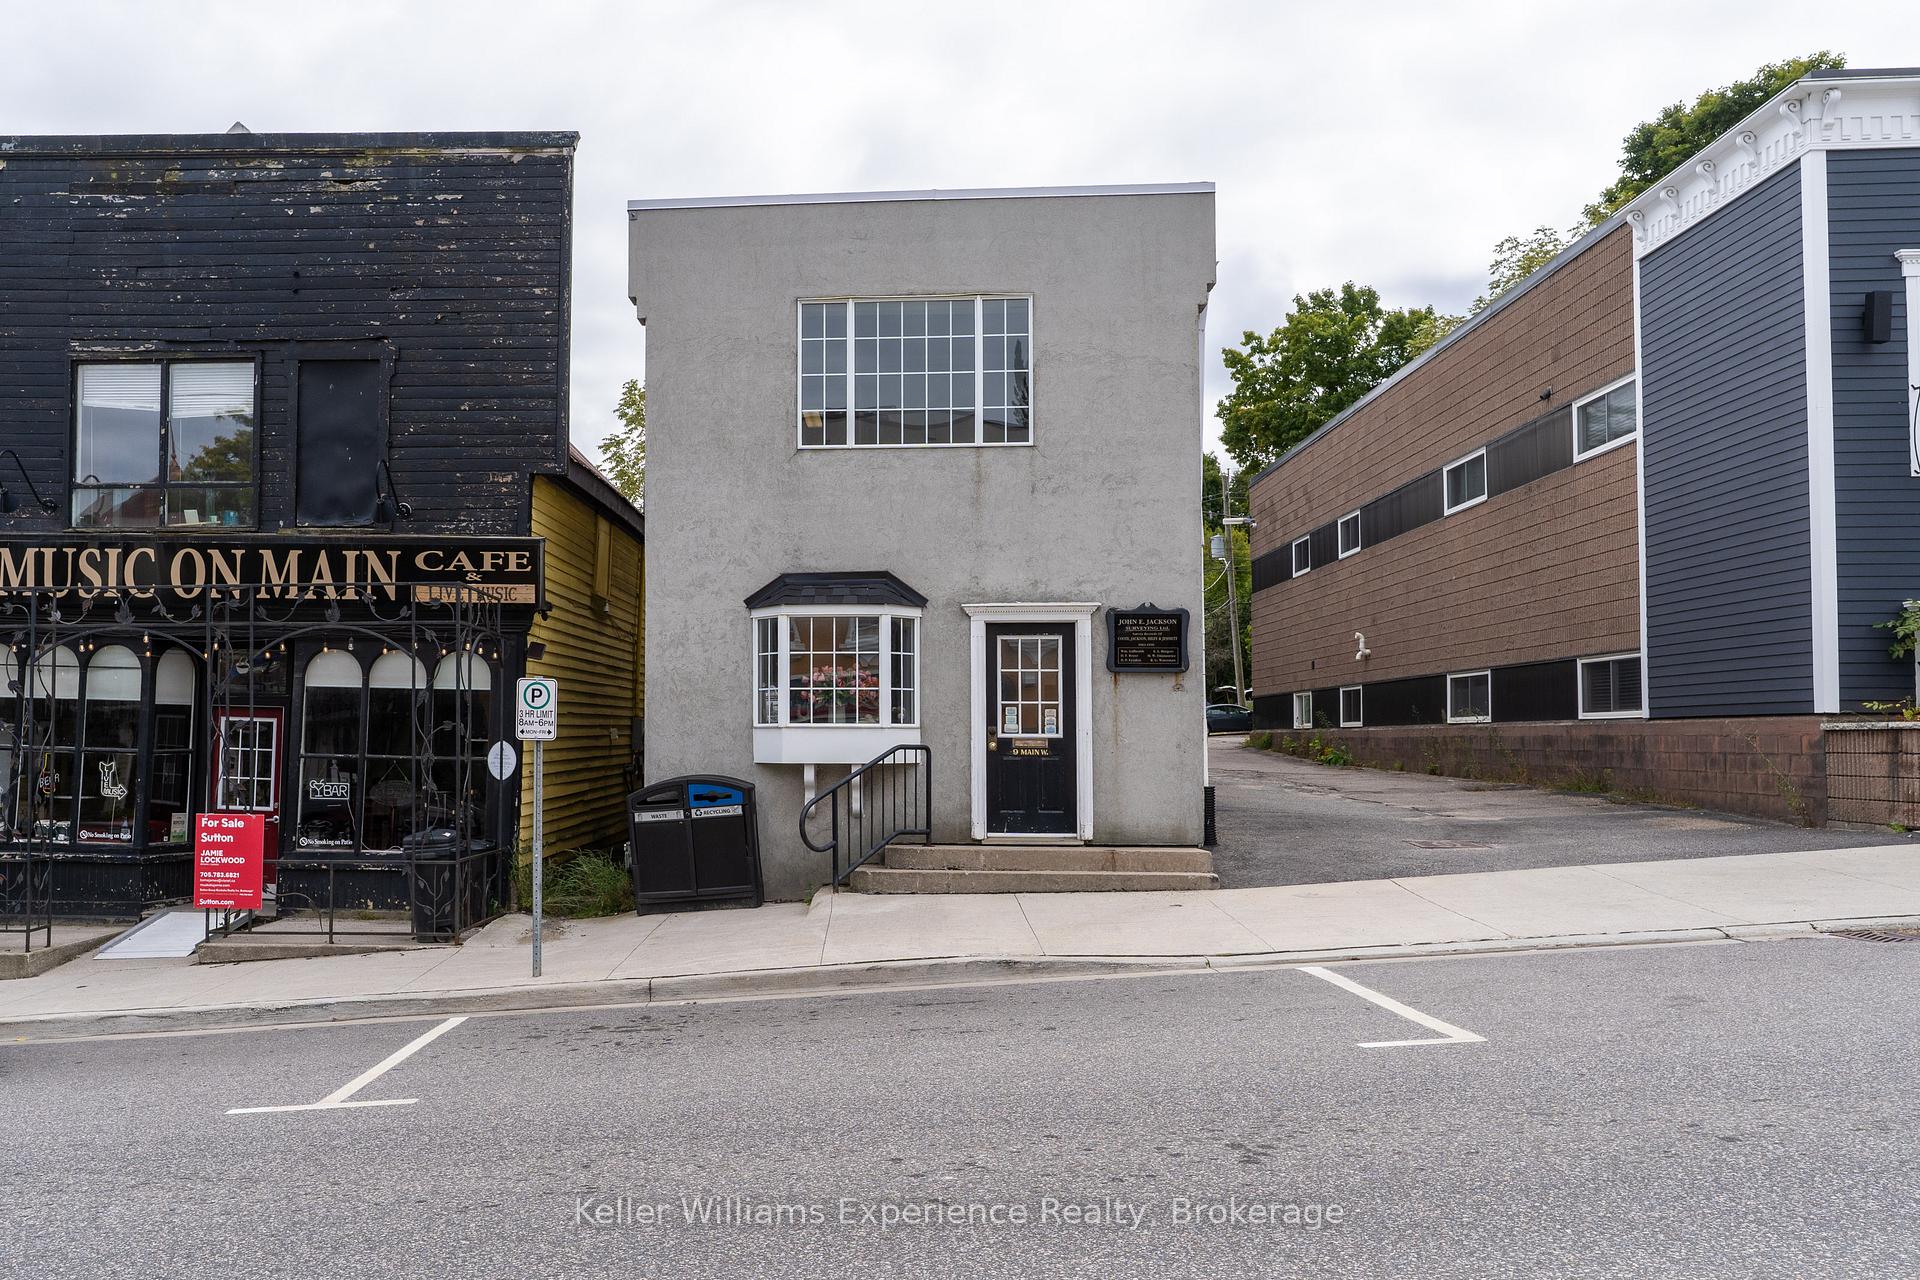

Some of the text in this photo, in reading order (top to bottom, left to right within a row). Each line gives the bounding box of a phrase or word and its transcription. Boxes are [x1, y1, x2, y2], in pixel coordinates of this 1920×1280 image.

[414, 550, 532, 572] CAFE
[0, 547, 401, 600] MUSIC ON MAIN
[465, 572, 482, 581] &
[531, 688, 543, 703] P
[519, 710, 553, 718] 3 HR LIMIT
[323, 785, 348, 797] BAR
[201, 818, 245, 828] For Sale
[95, 832, 113, 840] Smoking
[201, 832, 234, 843] Sutton
